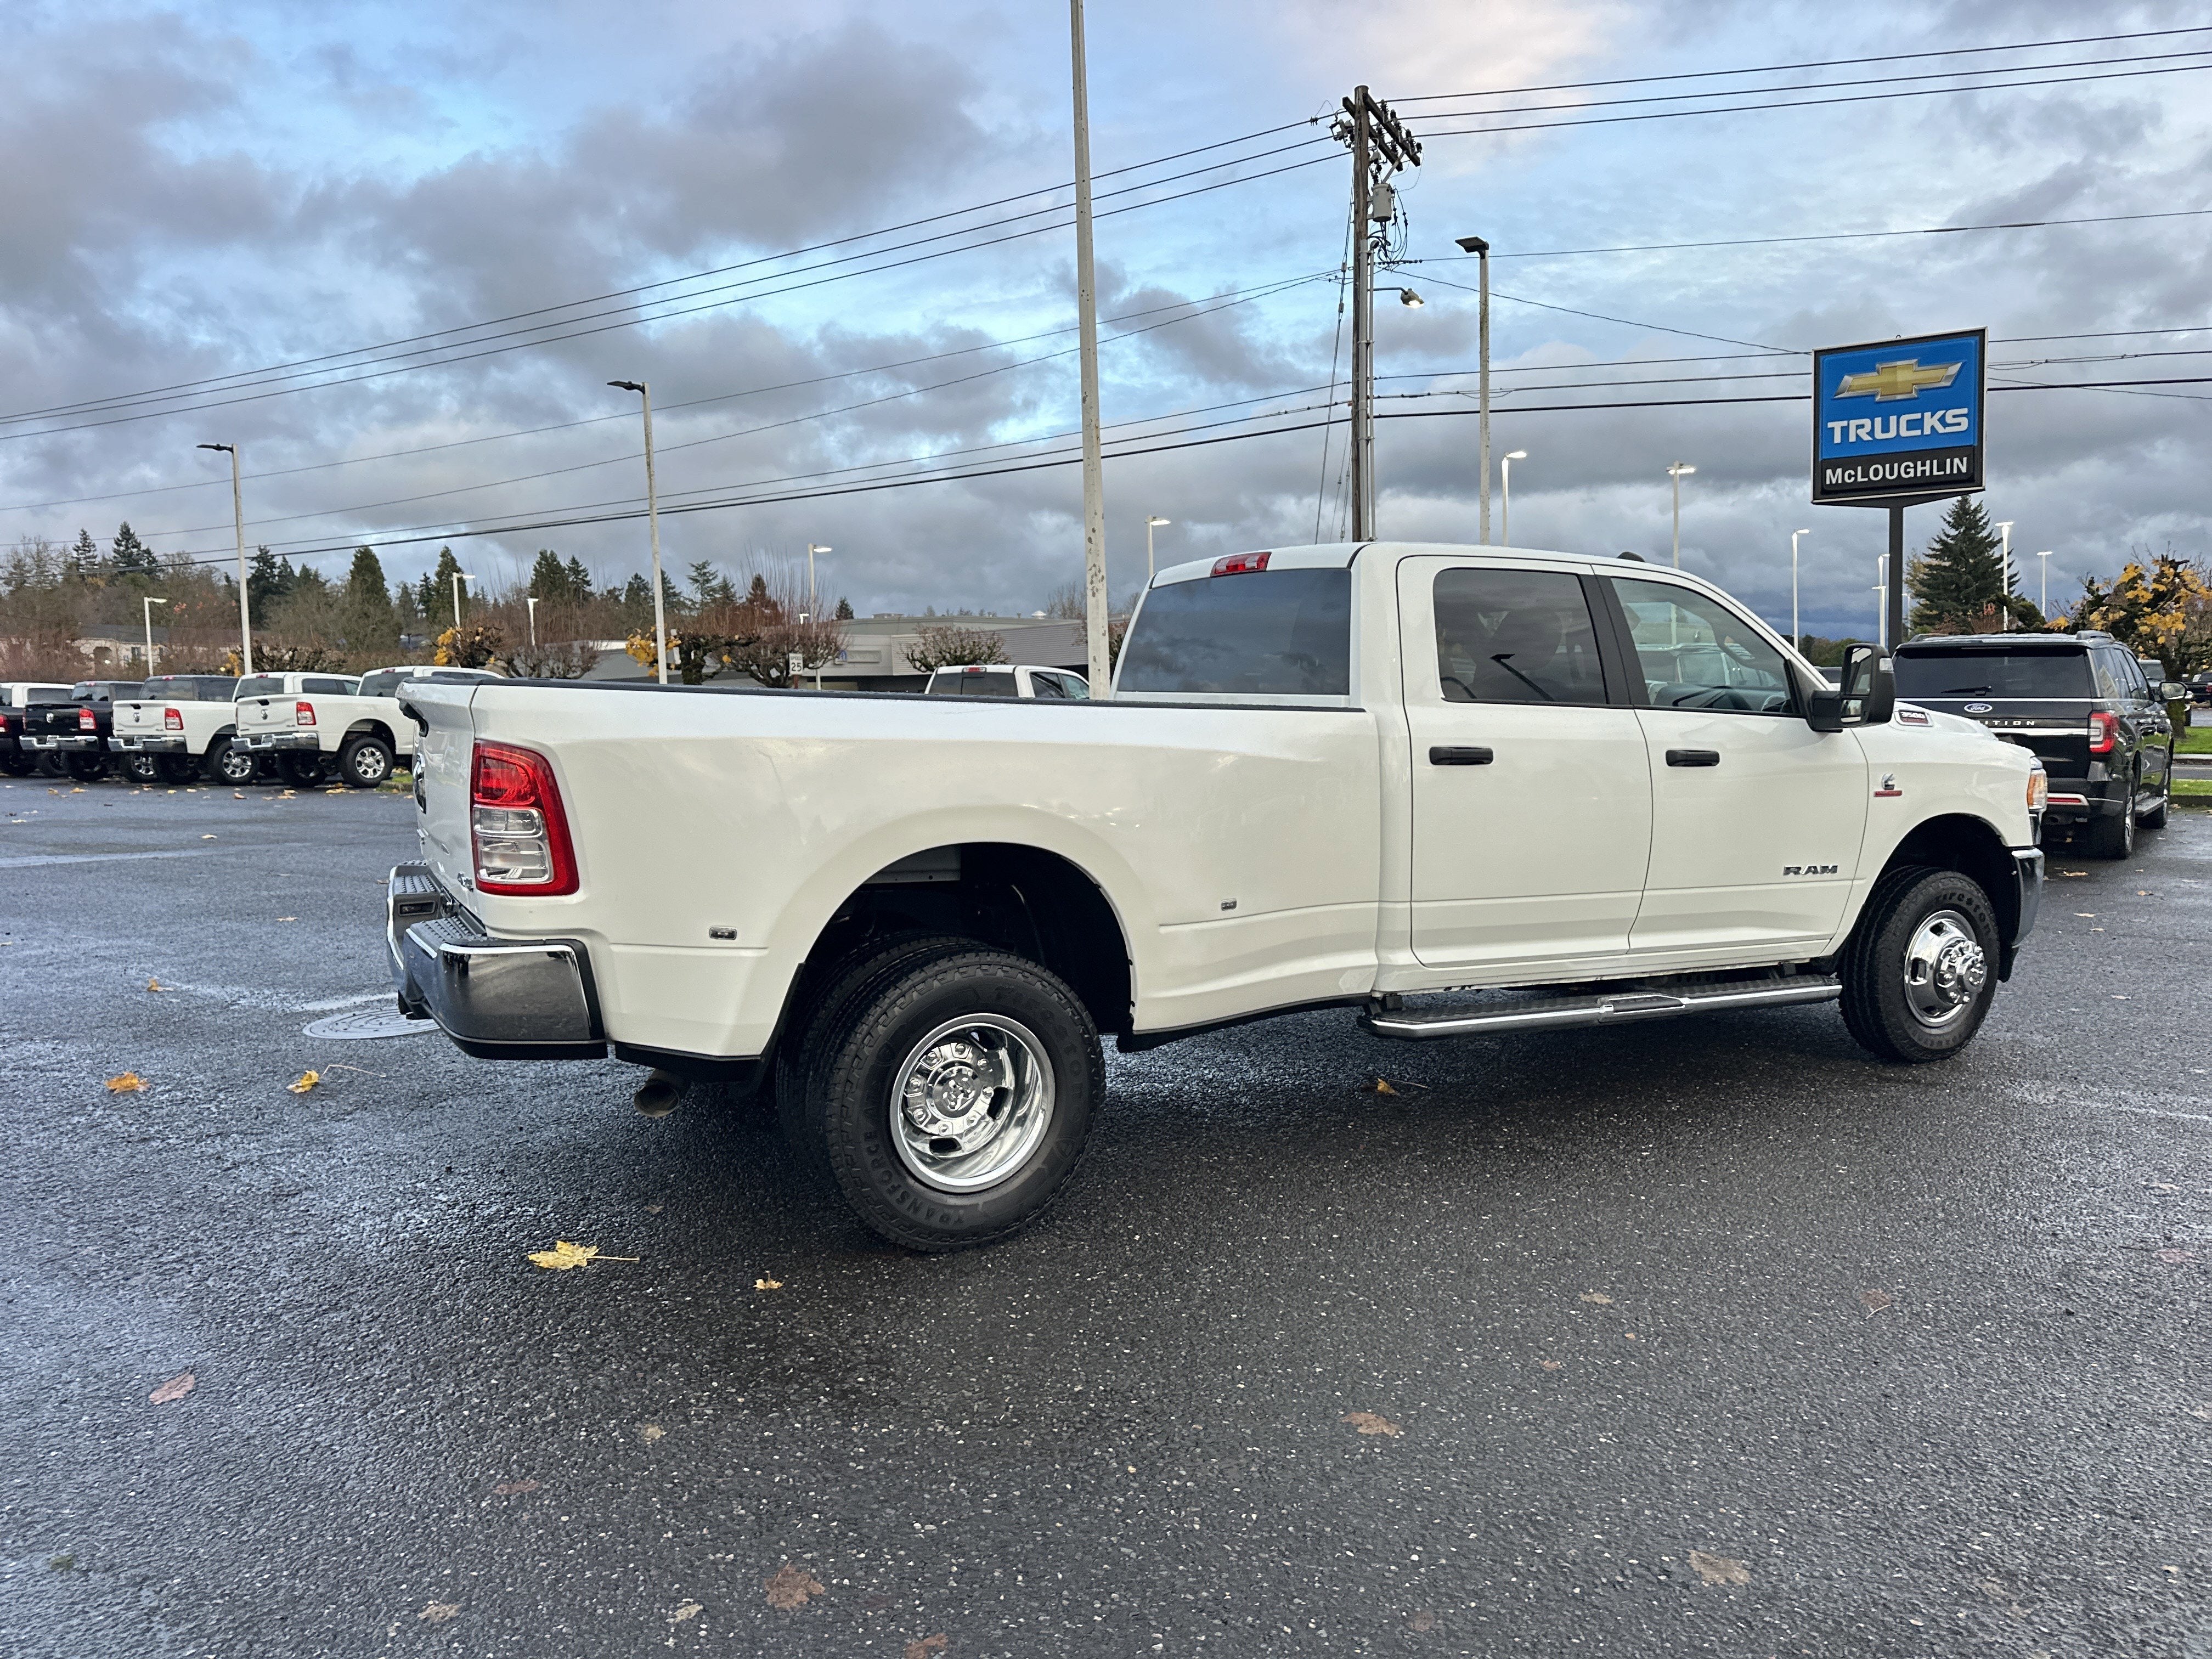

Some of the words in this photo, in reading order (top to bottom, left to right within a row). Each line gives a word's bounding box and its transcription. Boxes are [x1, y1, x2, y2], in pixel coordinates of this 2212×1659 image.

[1827, 408, 1968, 444] TRUCKS
[1825, 456, 1968, 484] McLOUGHLIN
[791, 662, 802, 672] 25
[1783, 865, 1838, 876] RAM
